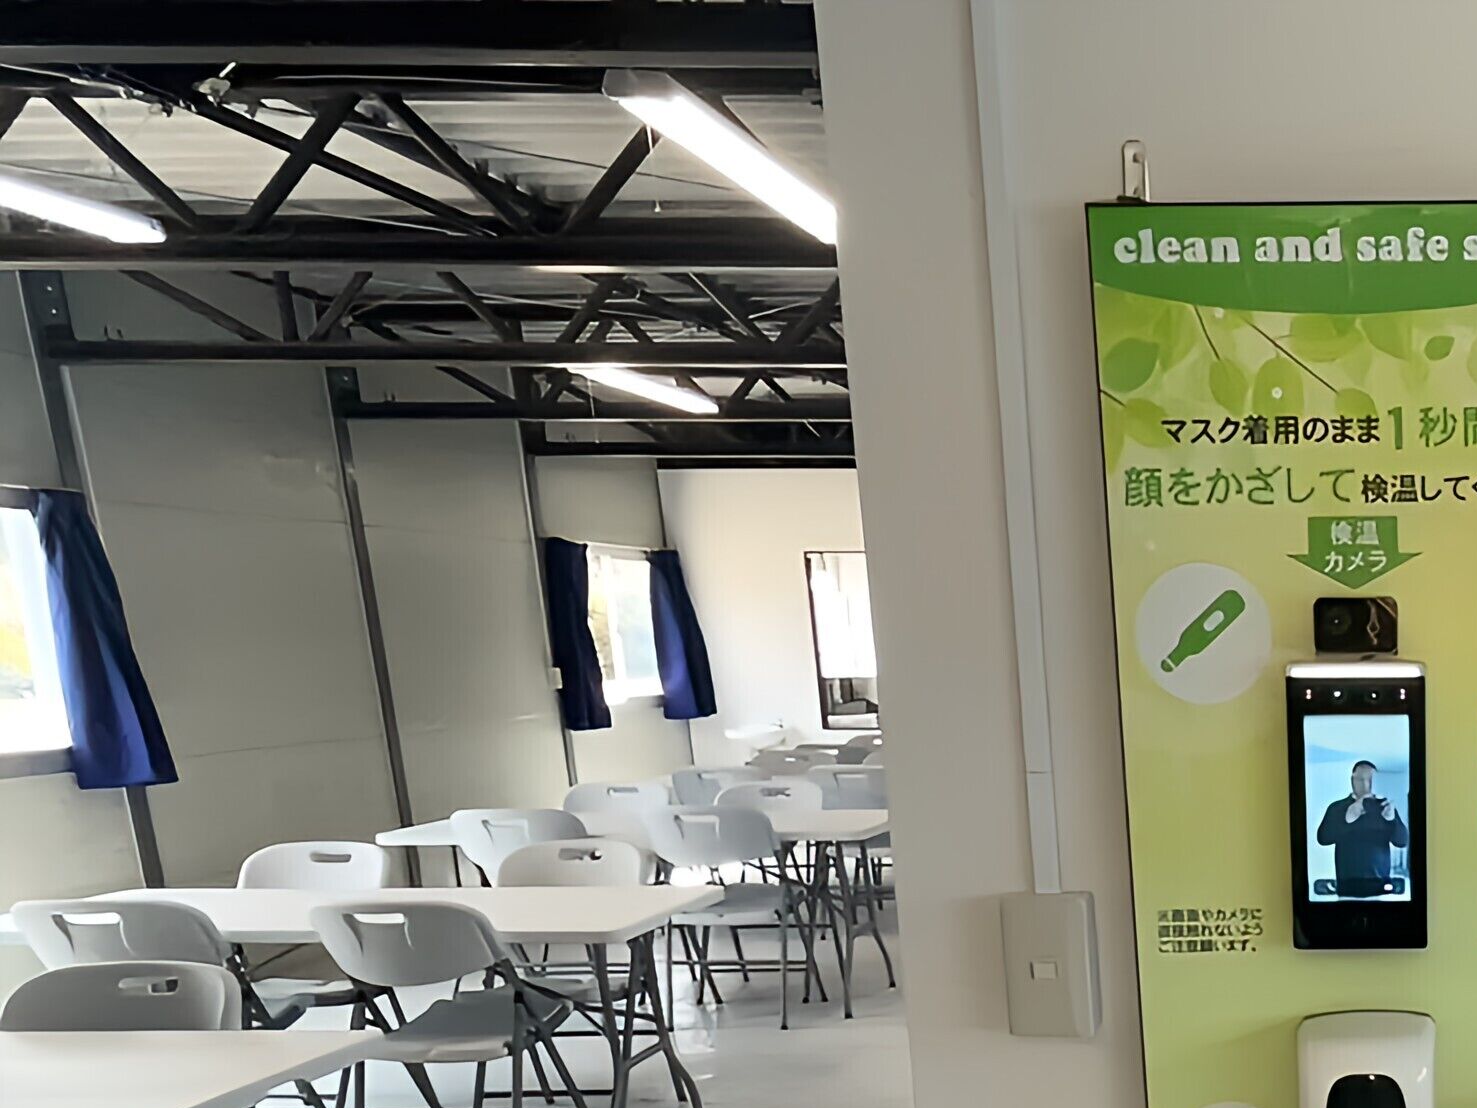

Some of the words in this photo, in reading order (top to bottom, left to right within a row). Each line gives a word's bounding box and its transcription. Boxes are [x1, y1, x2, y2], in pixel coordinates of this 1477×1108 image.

[1113, 228, 1240, 264] clean
[1254, 227, 1343, 263] and
[1356, 227, 1449, 263] safe
[1330, 520, 1380, 545] 検温
[1324, 550, 1388, 573] カメラ
